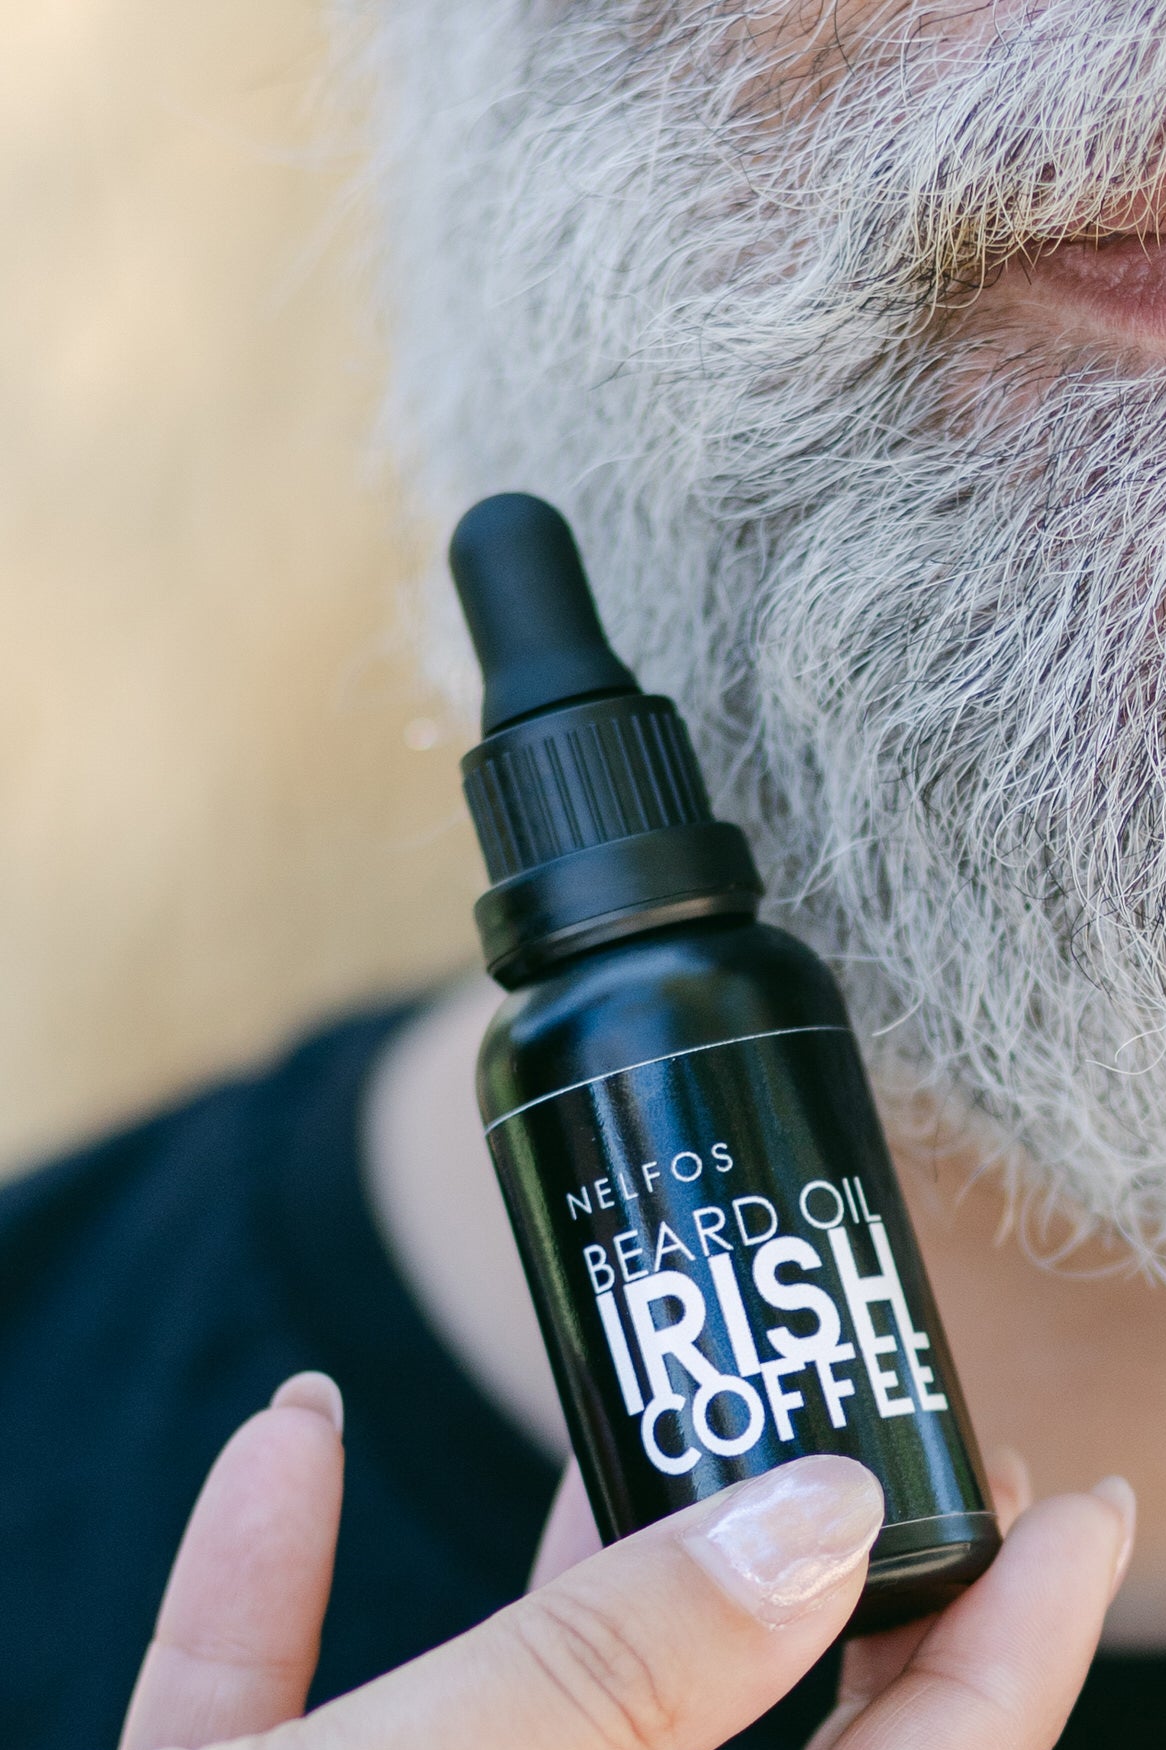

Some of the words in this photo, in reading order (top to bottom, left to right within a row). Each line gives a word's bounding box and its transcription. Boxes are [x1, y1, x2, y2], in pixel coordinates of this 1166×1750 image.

[566, 1142, 733, 1221] NELFOS
[582, 1195, 778, 1296] BEARD
[799, 1175, 883, 1231] OIL
[596, 1222, 914, 1417] IRISH
[640, 1331, 949, 1476] COFFEE
